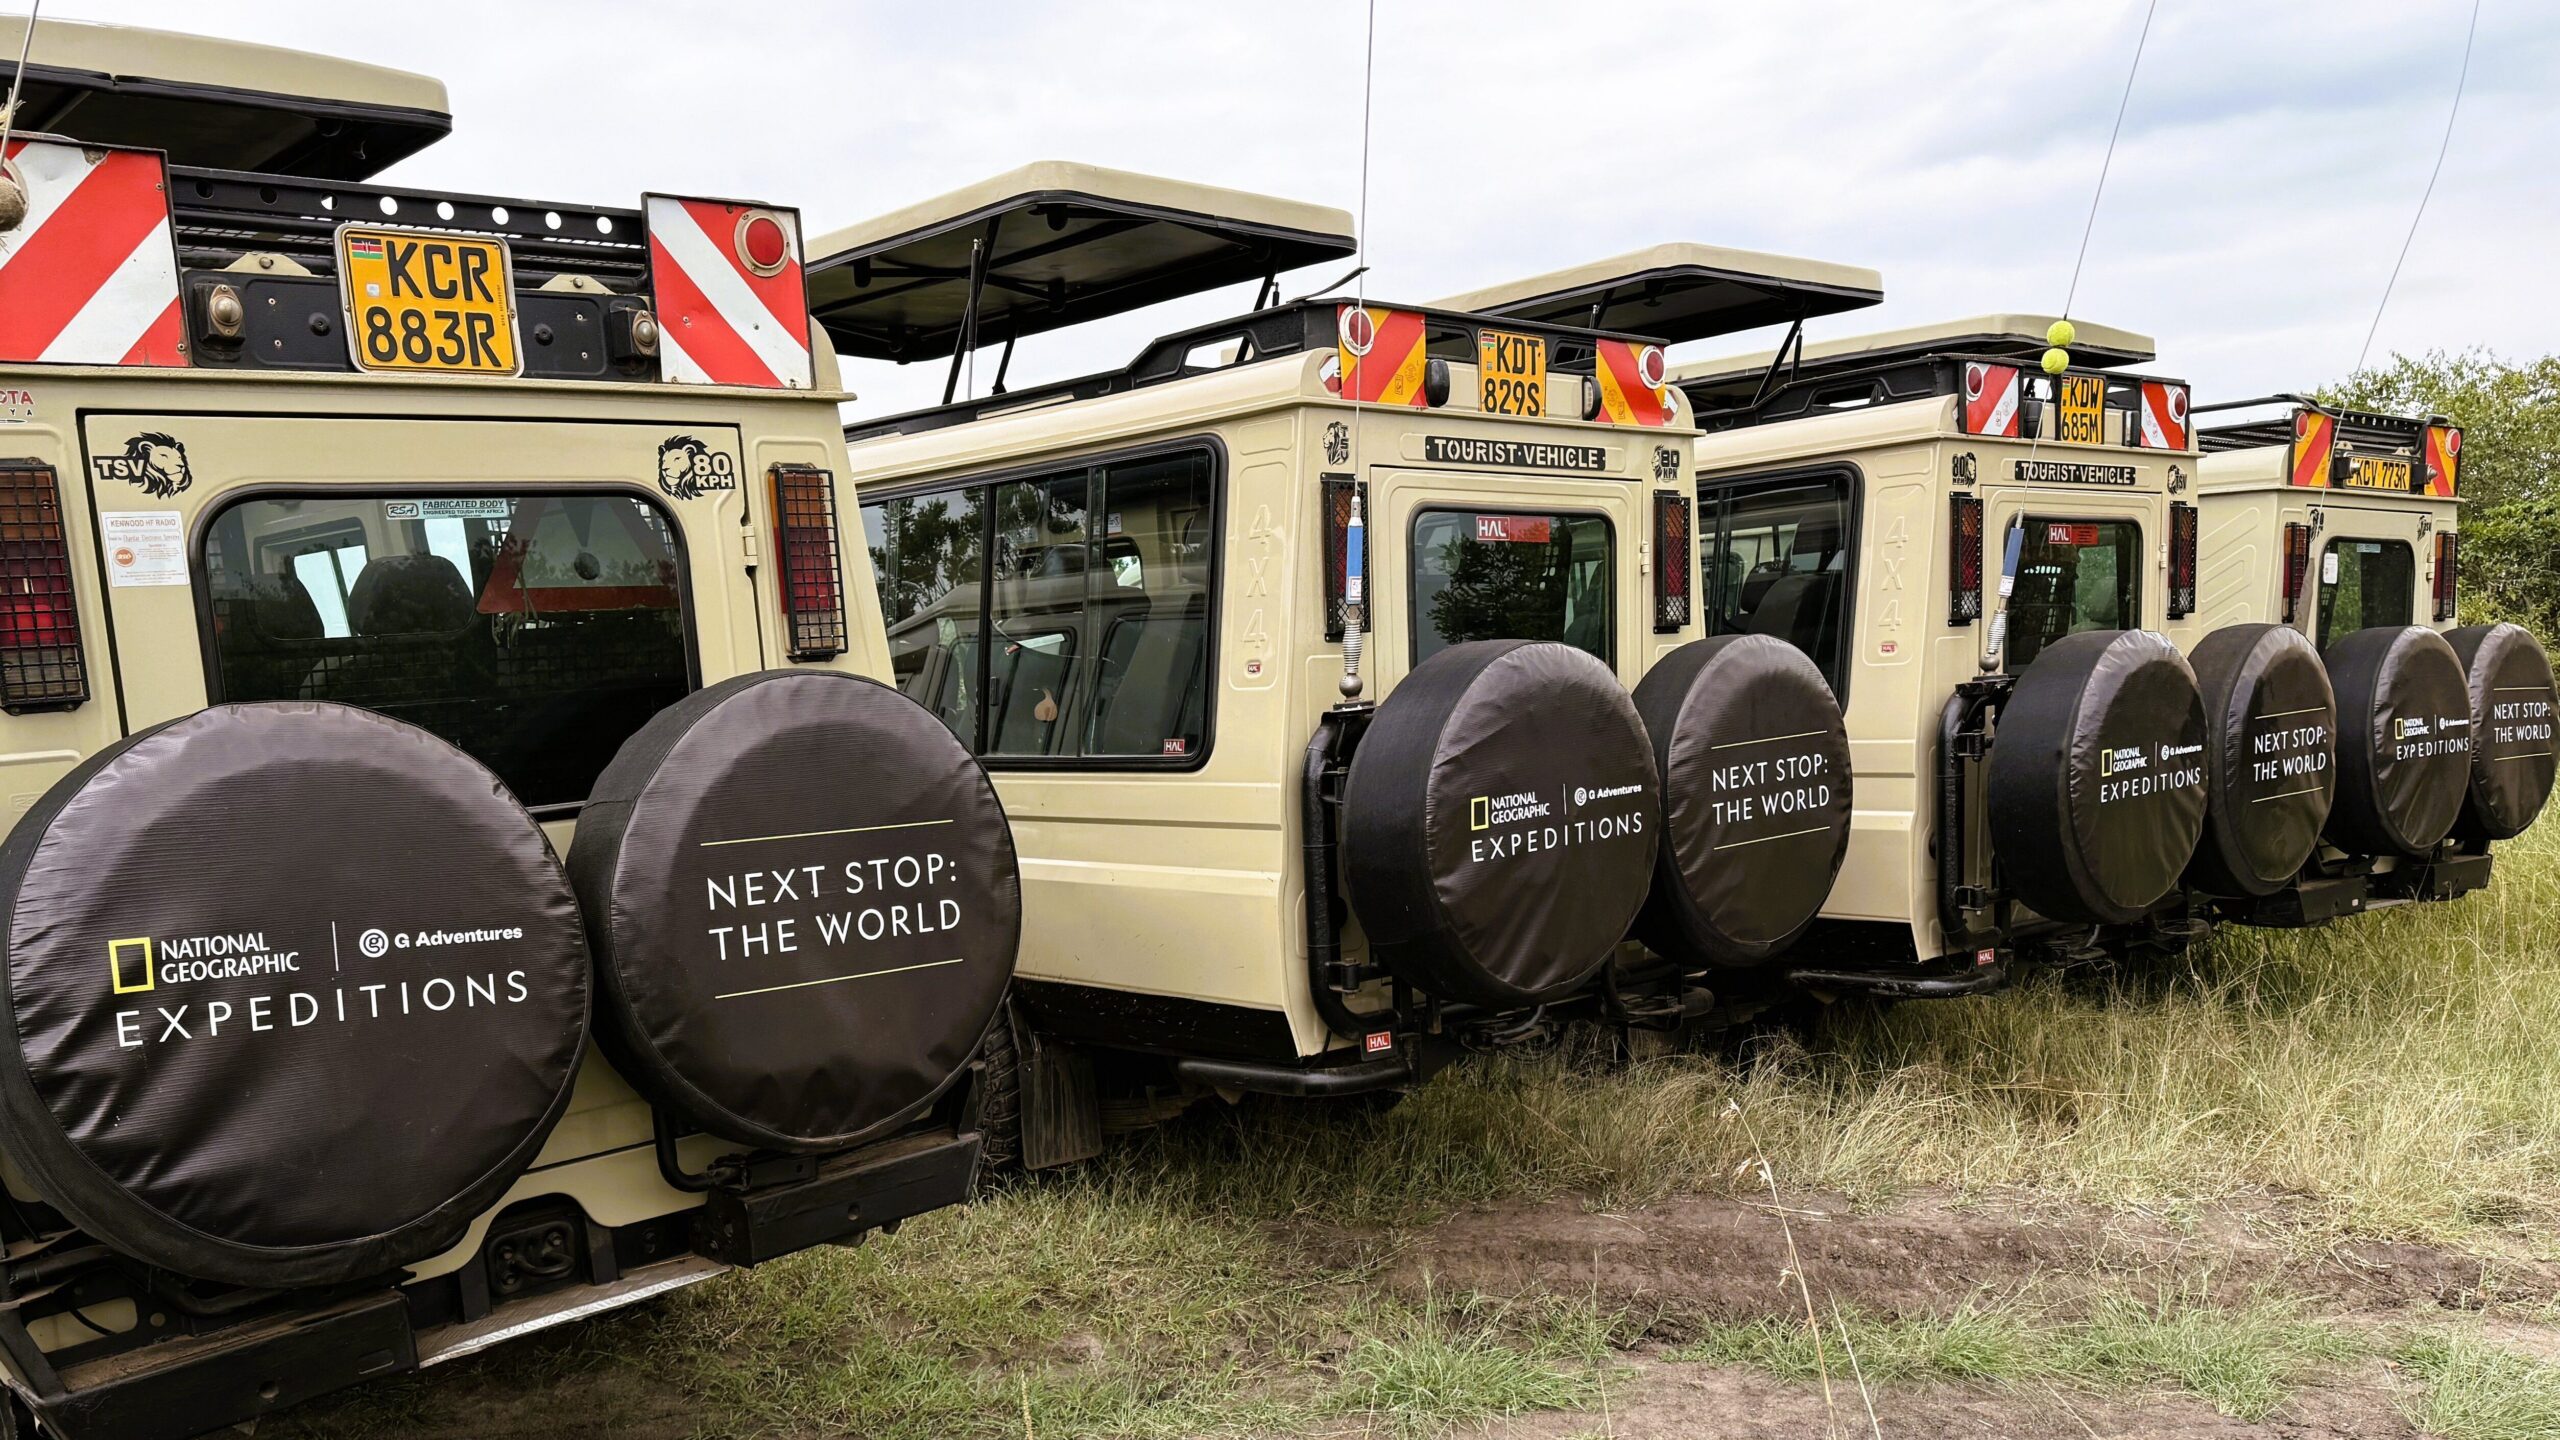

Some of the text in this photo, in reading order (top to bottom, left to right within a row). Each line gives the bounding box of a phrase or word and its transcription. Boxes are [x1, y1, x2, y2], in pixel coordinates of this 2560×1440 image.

[386, 240, 494, 303] KCR
[366, 306, 502, 367] 883R
[1497, 335, 1540, 376] KDT
[1484, 378, 1541, 417] 829S
[2069, 377, 2100, 409] KDW
[2061, 412, 2099, 442] 685M
[693, 454, 731, 476] 80
[1434, 438, 1599, 469] TOURIST VEHICLE
[1661, 449, 1680, 467] 80
[97, 459, 145, 477] TSV
[1952, 455, 1965, 477] 80
[2021, 462, 2131, 484] TOURIST VEHICLE
[2355, 459, 2407, 489] KCV 773R
[695, 475, 733, 488] KPH
[388, 505, 415, 515] RSA
[422, 499, 504, 509] FABRICATED BODY
[110, 519, 145, 528] KENWOOD
[155, 518, 176, 526] RADIO
[1478, 519, 1507, 537] HAL
[2050, 527, 2070, 541] HAL
[2494, 702, 2551, 720] NEXT STOP:
[2254, 725, 2327, 755] NEXT STOP:
[2494, 723, 2551, 744] THE WORLD
[1165, 741, 1183, 752] HAL
[2113, 746, 2141, 760] NATIONAL
[2396, 737, 2469, 760] EXPEDITIONS
[1712, 753, 1828, 792] NEXT STOP:
[2253, 752, 2327, 782] THE WORLD
[1597, 784, 1642, 799] Adventures
[2101, 767, 2201, 803] EXPEDITIONS
[1491, 791, 1538, 810] NATIONAL
[1712, 785, 1830, 825] THE WORLD
[1491, 802, 1550, 825] GEOGRAPHIC
[1471, 811, 1643, 863] EXPEDITIONS
[707, 853, 957, 911] NEXT STOP:
[394, 927, 523, 949] G Adventures
[708, 899, 961, 961] THE WORLD
[160, 932, 270, 961] NATIONAL
[160, 951, 300, 984] GEOGRAPHIC
[116, 970, 528, 1047] EXPEDITIONS
[1369, 1035, 1389, 1048] HAL
